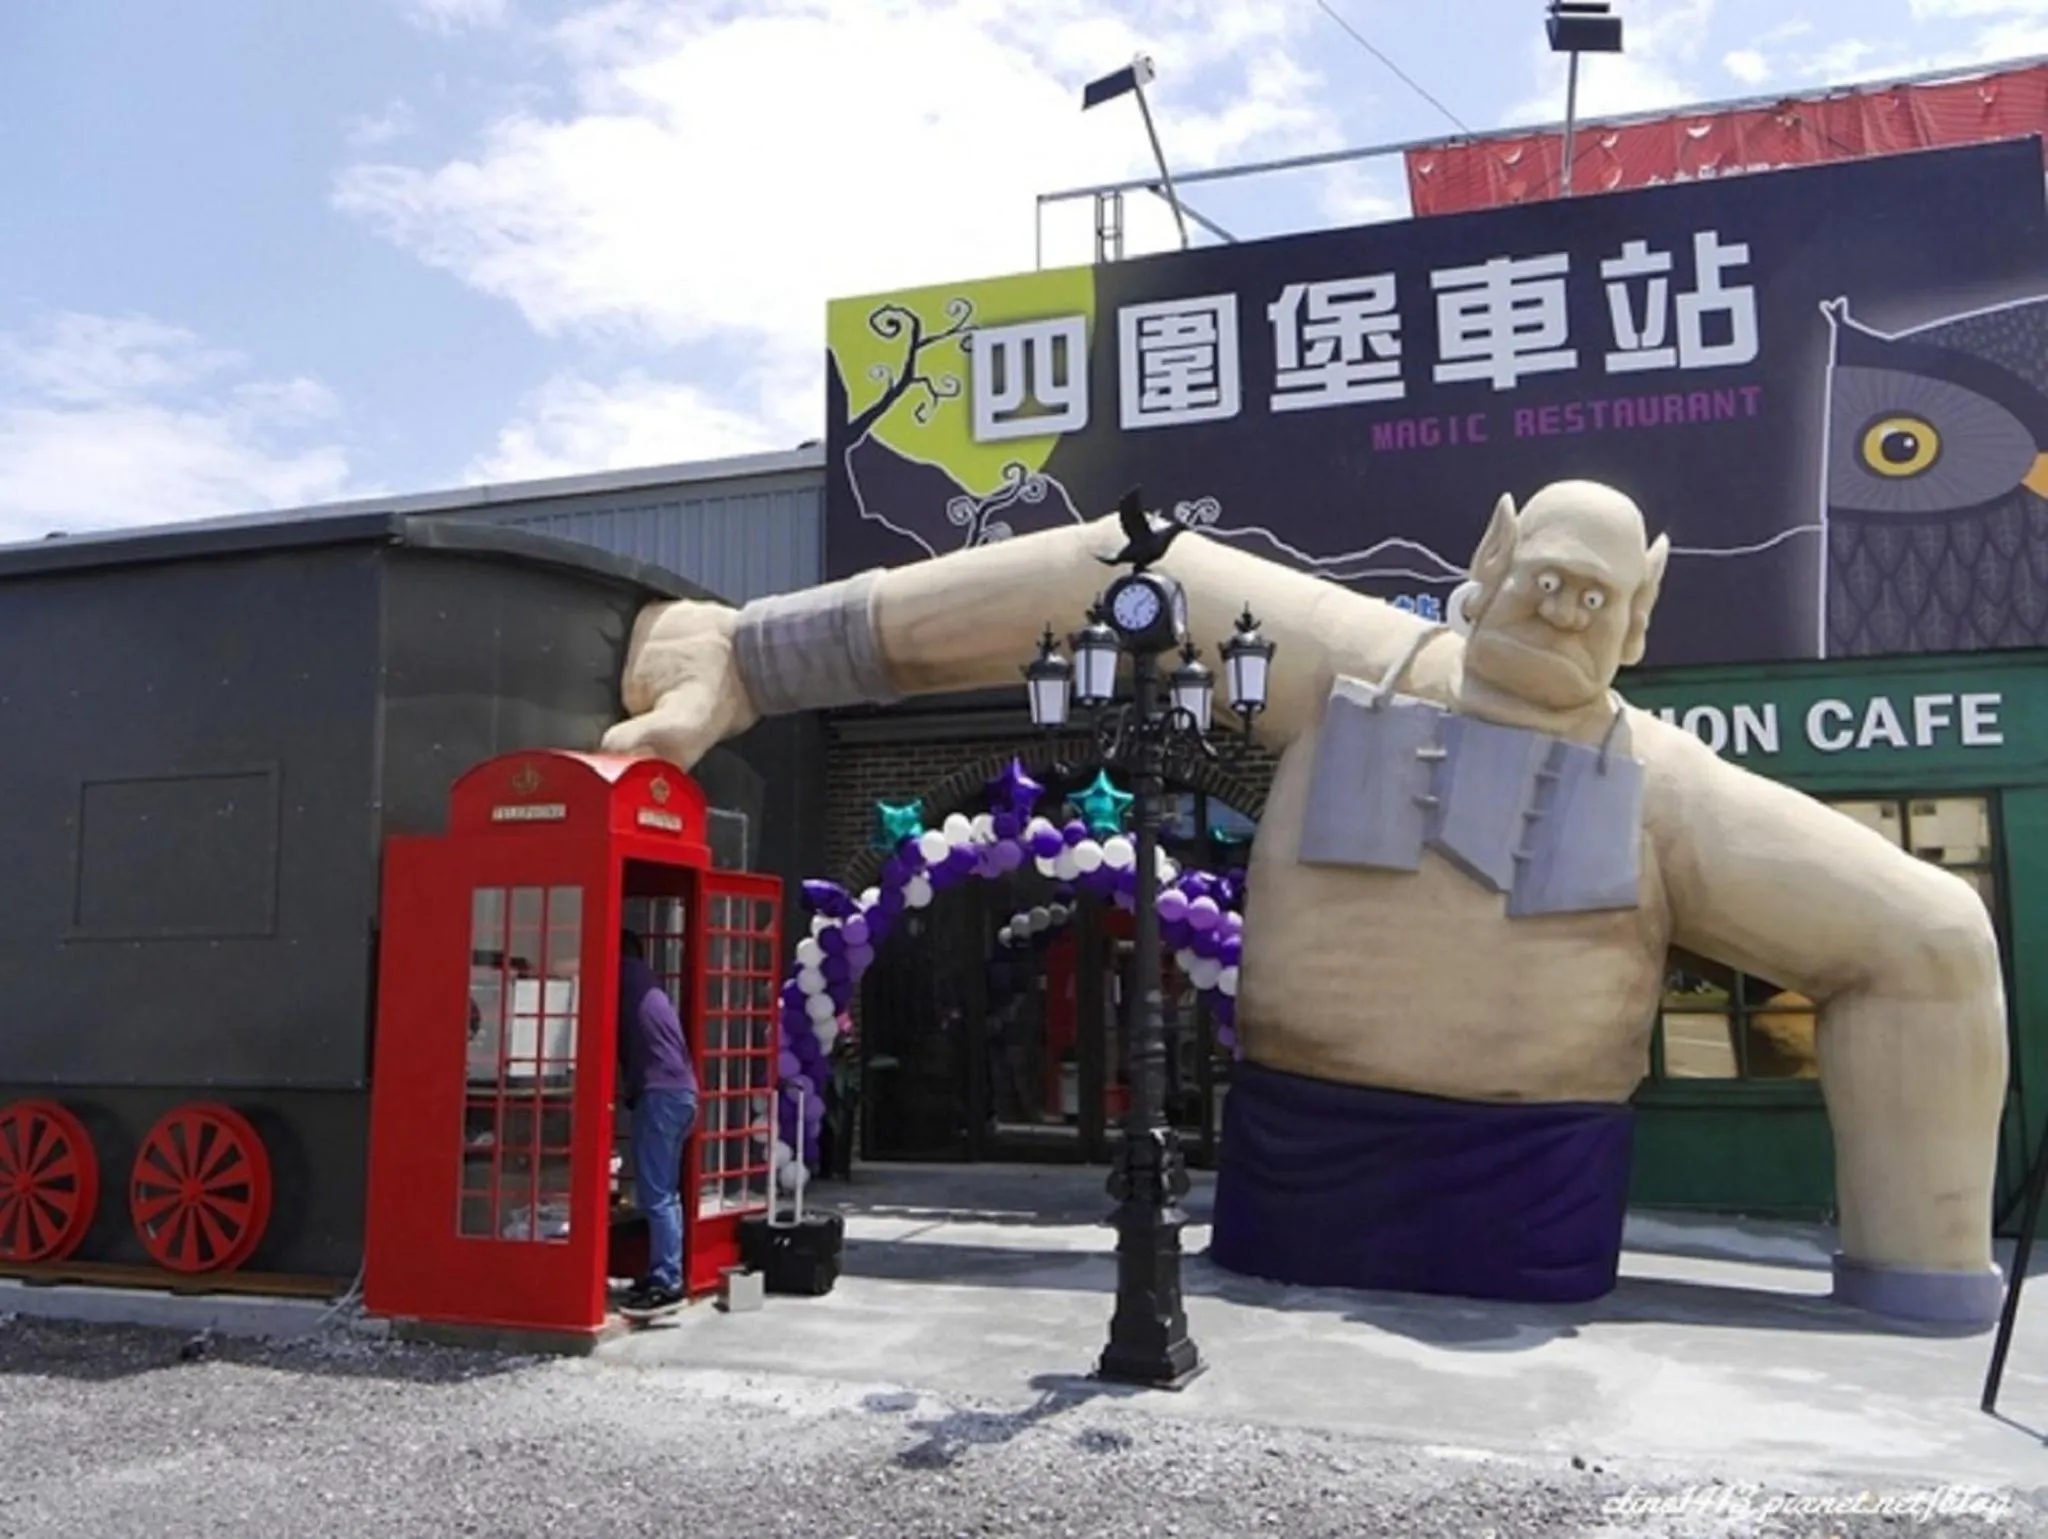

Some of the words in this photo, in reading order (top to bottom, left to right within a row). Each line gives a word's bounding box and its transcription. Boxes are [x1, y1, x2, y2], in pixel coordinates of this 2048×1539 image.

[973, 231, 1758, 442] 四圍堡車站
[1372, 414, 1488, 451] MAGIC
[1514, 386, 1761, 437] RESTAURANT
[1806, 693, 2003, 750] CAFE
